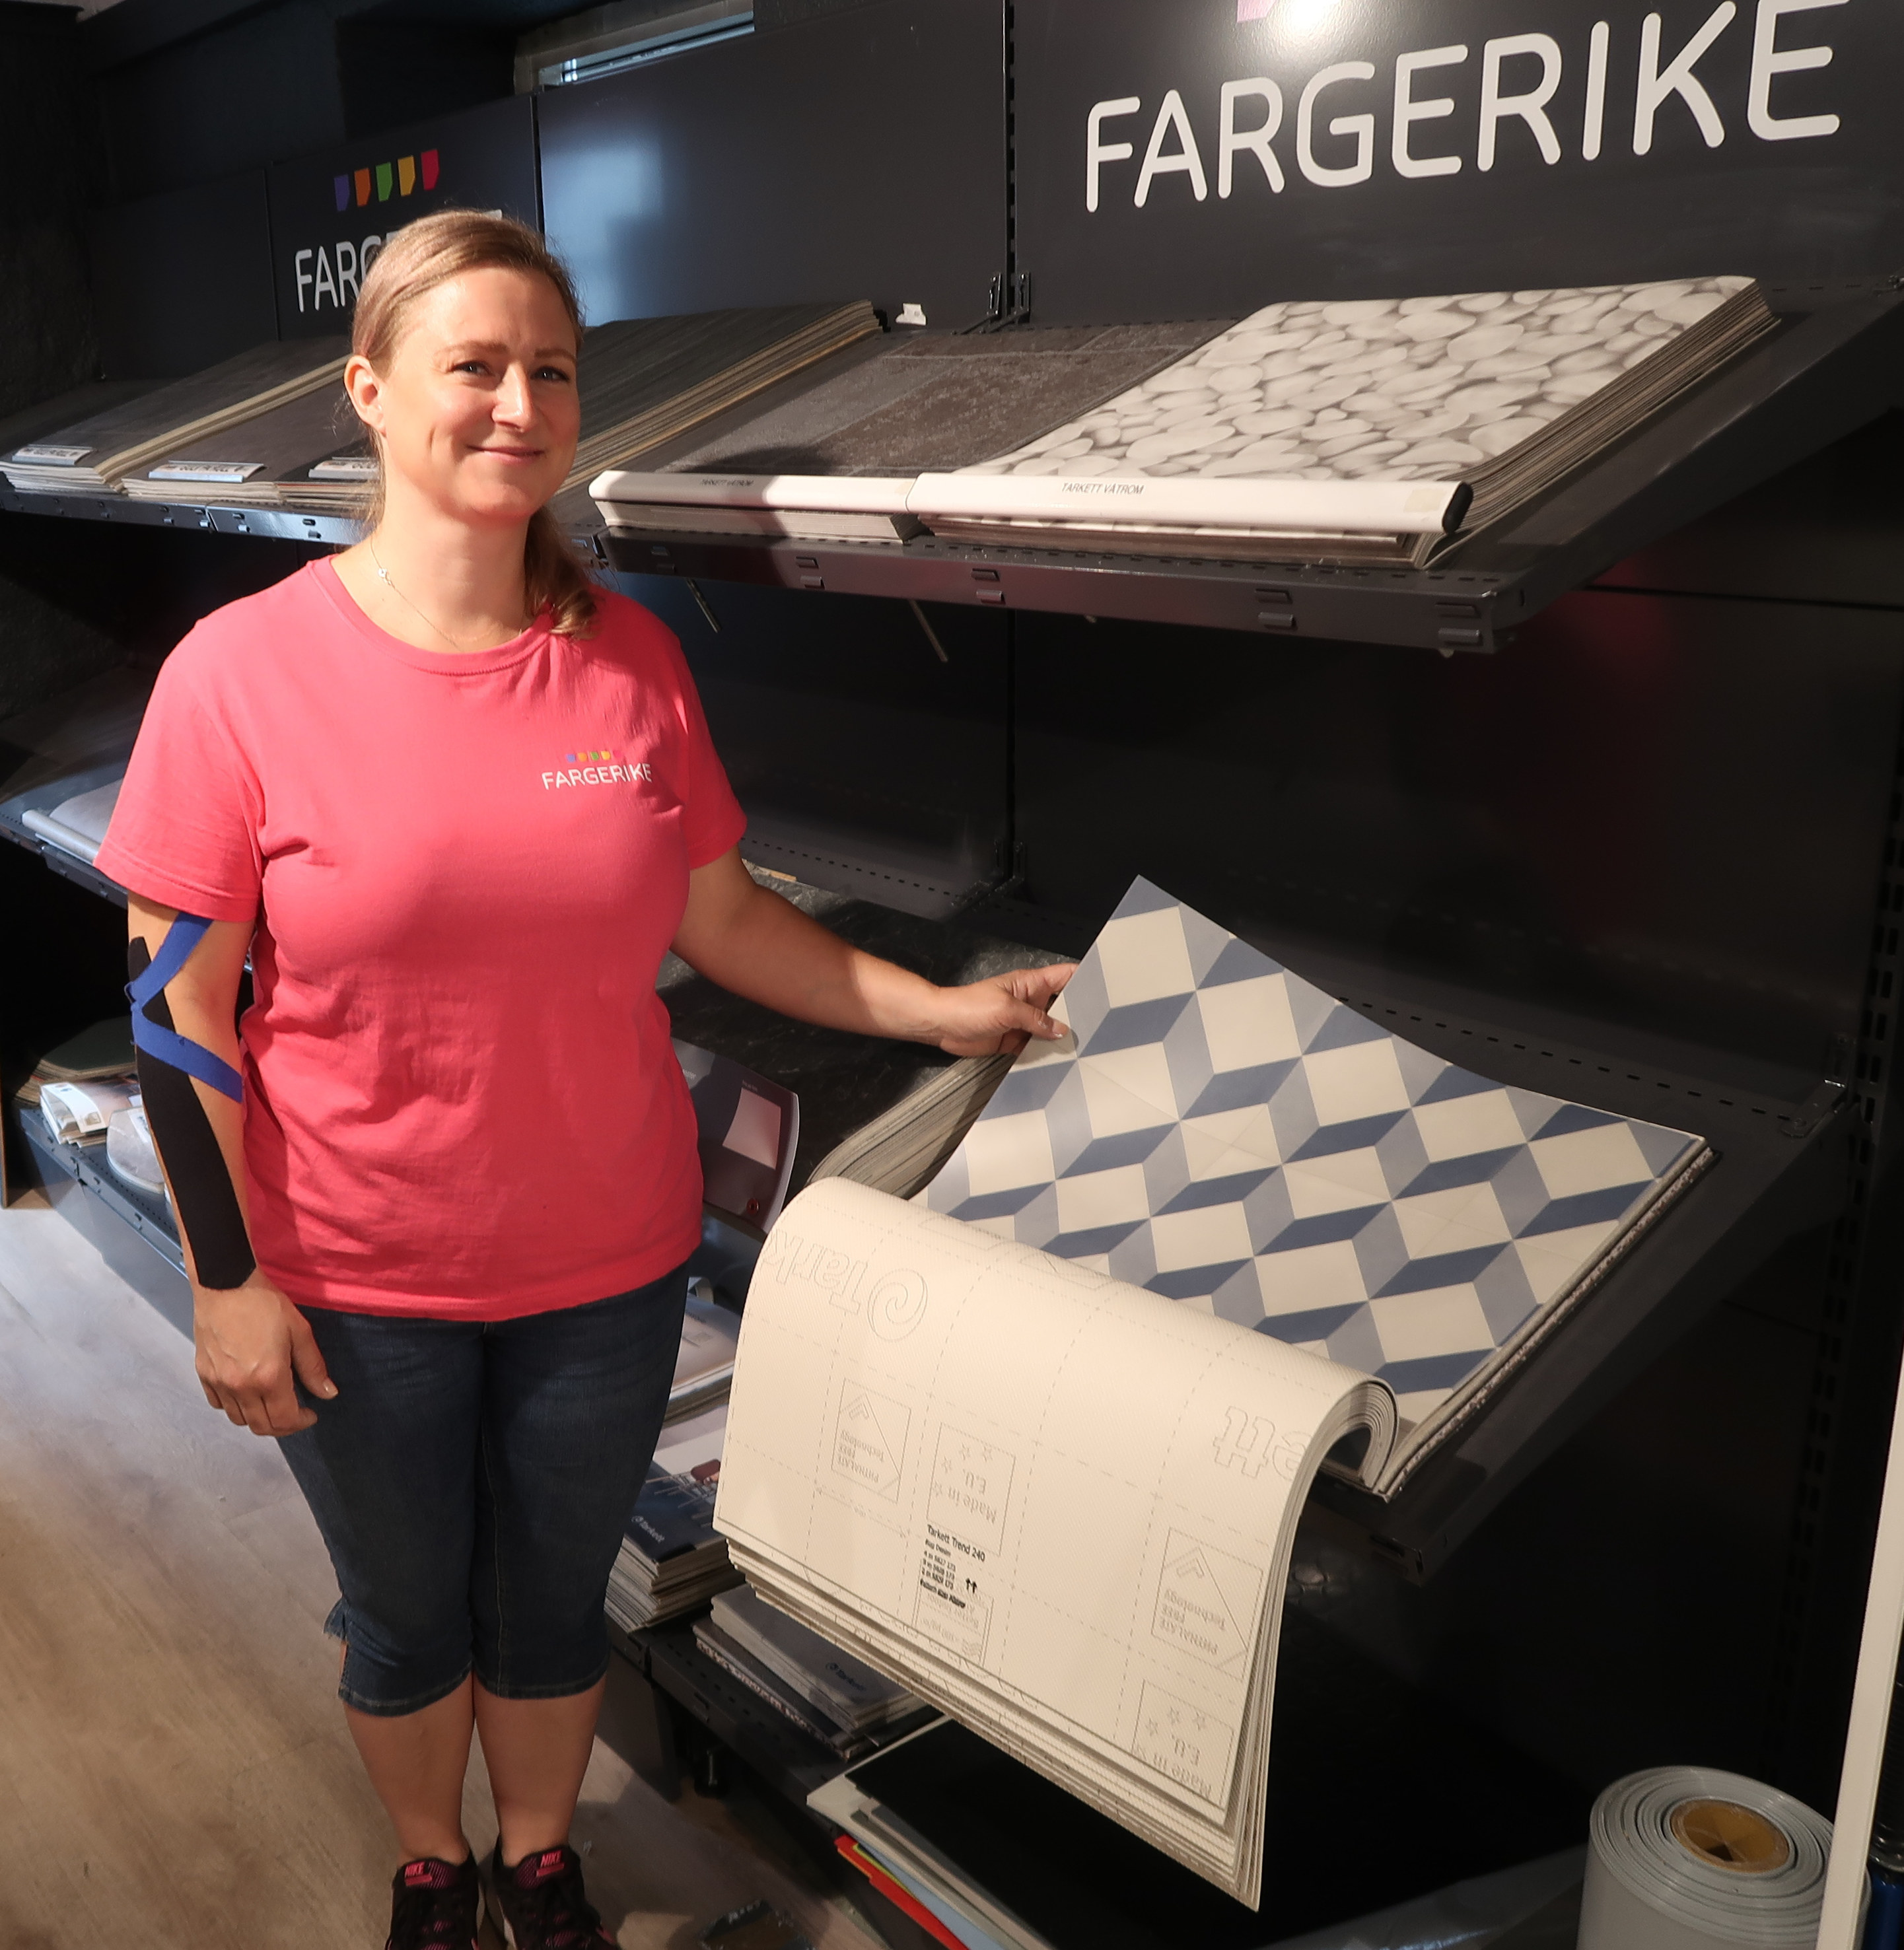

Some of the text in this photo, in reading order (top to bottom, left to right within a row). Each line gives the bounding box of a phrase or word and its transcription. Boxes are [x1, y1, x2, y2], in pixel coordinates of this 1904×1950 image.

[1086, 0, 1850, 212] FARGERIKE
[1061, 483, 1103, 493] TARKETT
[542, 763, 652, 790] FARGERIKE
[948, 1486, 996, 1524] Made in
[927, 1524, 985, 1562] Tarkett Trend 240
[405, 1861, 425, 1877] NIKE
[540, 1850, 561, 1867] NIKE
